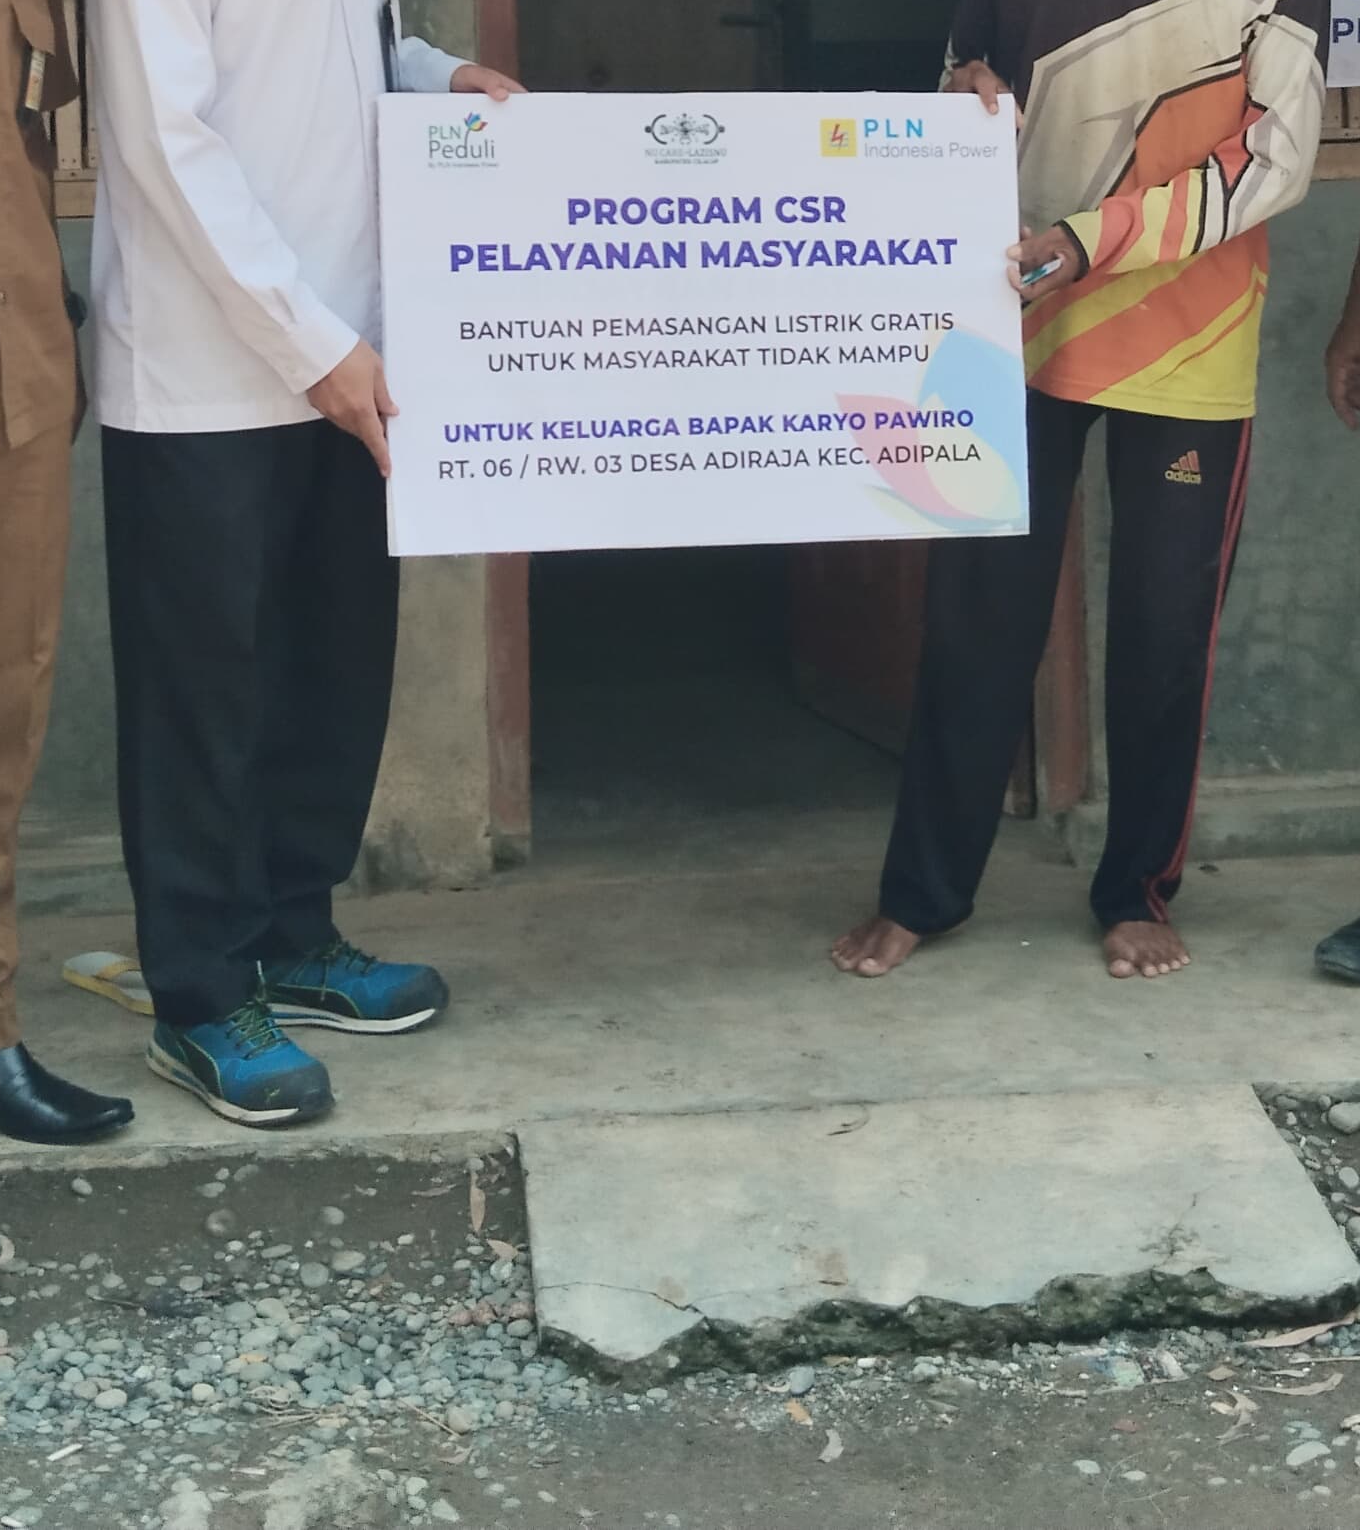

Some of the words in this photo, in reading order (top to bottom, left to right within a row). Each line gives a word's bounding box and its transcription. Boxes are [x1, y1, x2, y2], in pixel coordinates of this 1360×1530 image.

[429, 126, 461, 139] PLN
[864, 119, 923, 138] PLN
[430, 139, 495, 158] Peduli
[864, 143, 943, 158] Indonesia
[949, 142, 998, 158] Power
[568, 197, 761, 225] PROGRAM
[776, 196, 845, 223] CSR
[451, 242, 686, 272] PELAYANAN
[701, 239, 957, 268] MASYARAKAT
[461, 320, 582, 339] BANTUAN
[593, 316, 766, 336] PEMASANGAN
[776, 314, 863, 333] LISTRIK
[871, 313, 953, 331] GRATIS
[489, 352, 575, 372] UNTUK
[584, 349, 750, 370] MASYARAKAT
[757, 347, 830, 365] TIDAK
[839, 345, 928, 363] MAMPU
[445, 422, 533, 442] UNTUK
[543, 419, 680, 439] KELUARGA
[689, 415, 774, 435] BAPAK
[783, 413, 866, 432] KARYO
[875, 410, 974, 429] PAWIRO
[439, 460, 474, 479] RT.
[483, 459, 512, 477] 06
[520, 454, 528, 479] /
[538, 456, 585, 475] RW.
[595, 455, 622, 473] 03
[632, 453, 696, 472] DESA
[704, 449, 810, 470] ADIRAJA
[819, 447, 870, 466] KEC.
[877, 444, 980, 464] ADIPALA
